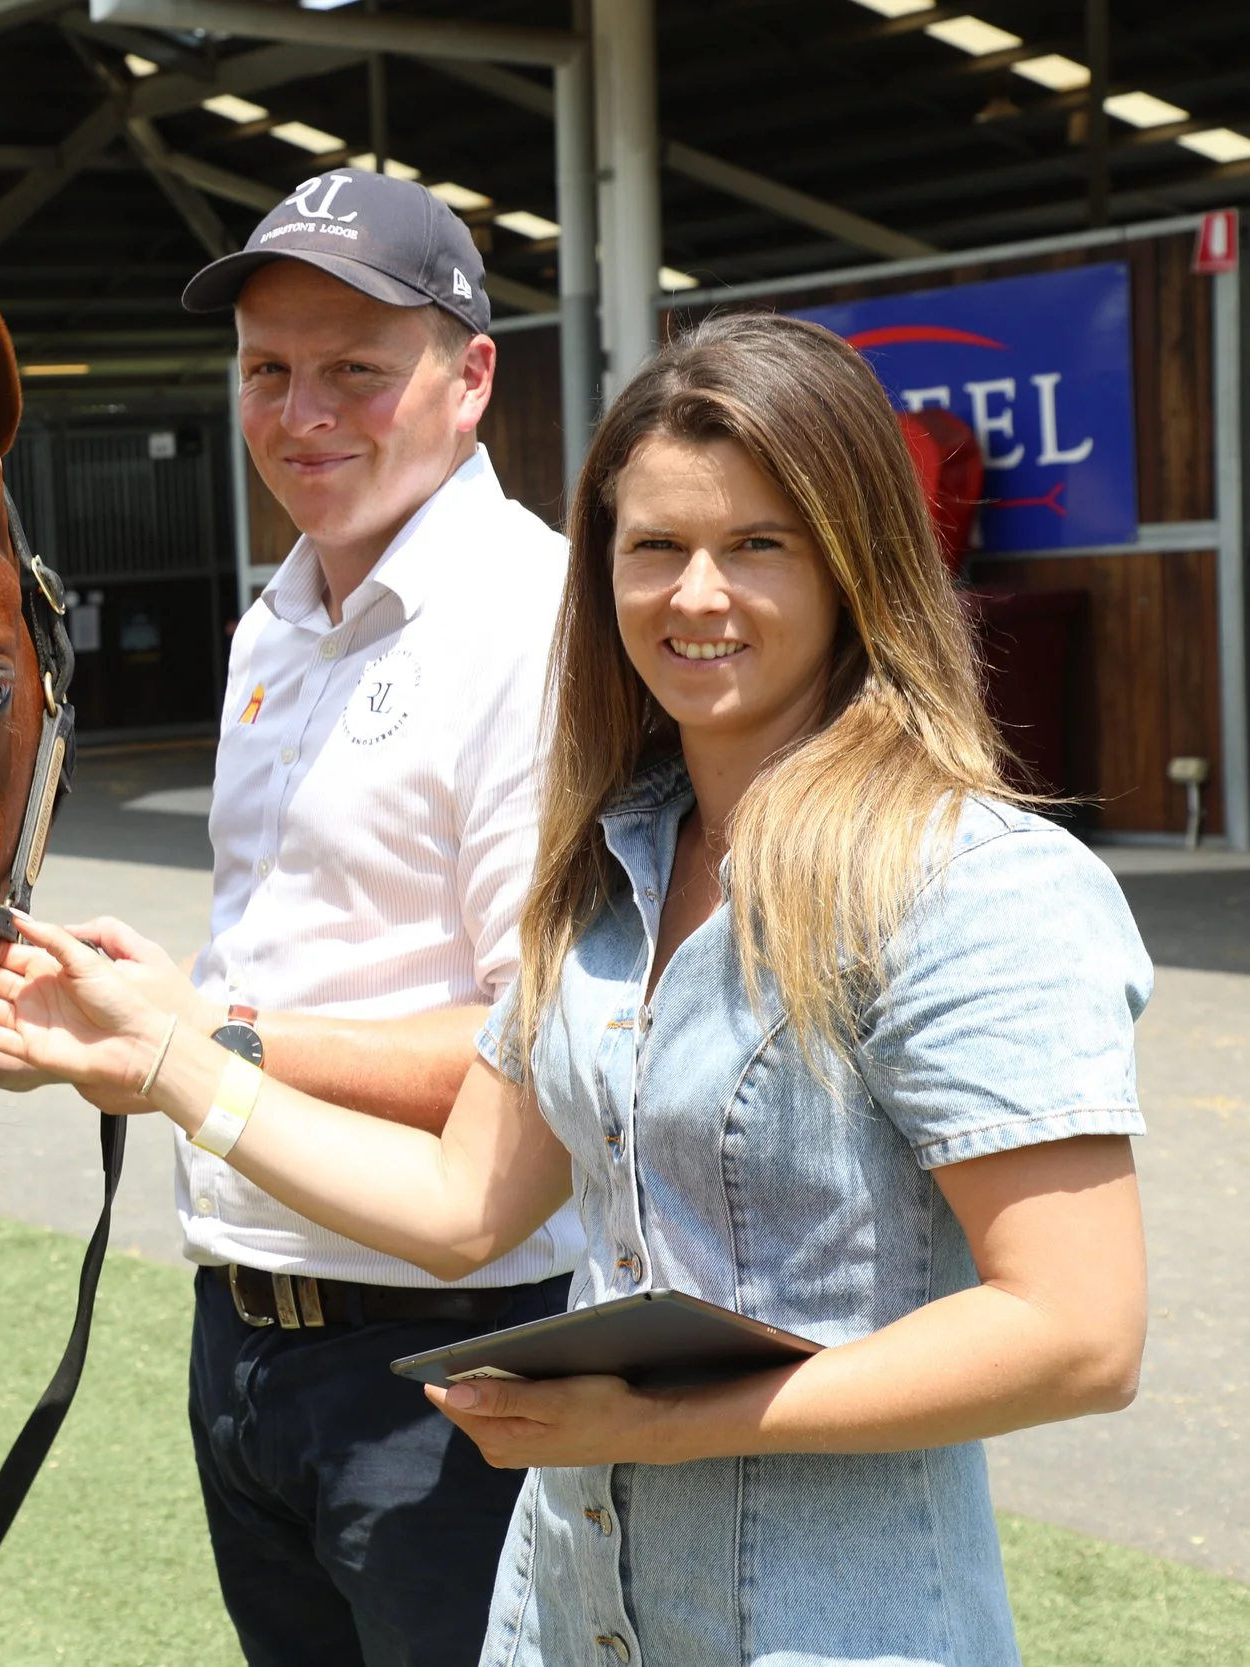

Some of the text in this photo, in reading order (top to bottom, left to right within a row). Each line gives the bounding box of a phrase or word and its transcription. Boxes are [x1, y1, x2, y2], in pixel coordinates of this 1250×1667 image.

[260, 222, 358, 244] RIVERSTONE LODGE
[900, 372, 1094, 470] EL
[31, 751, 63, 871] RIVERSTONE LODGE
